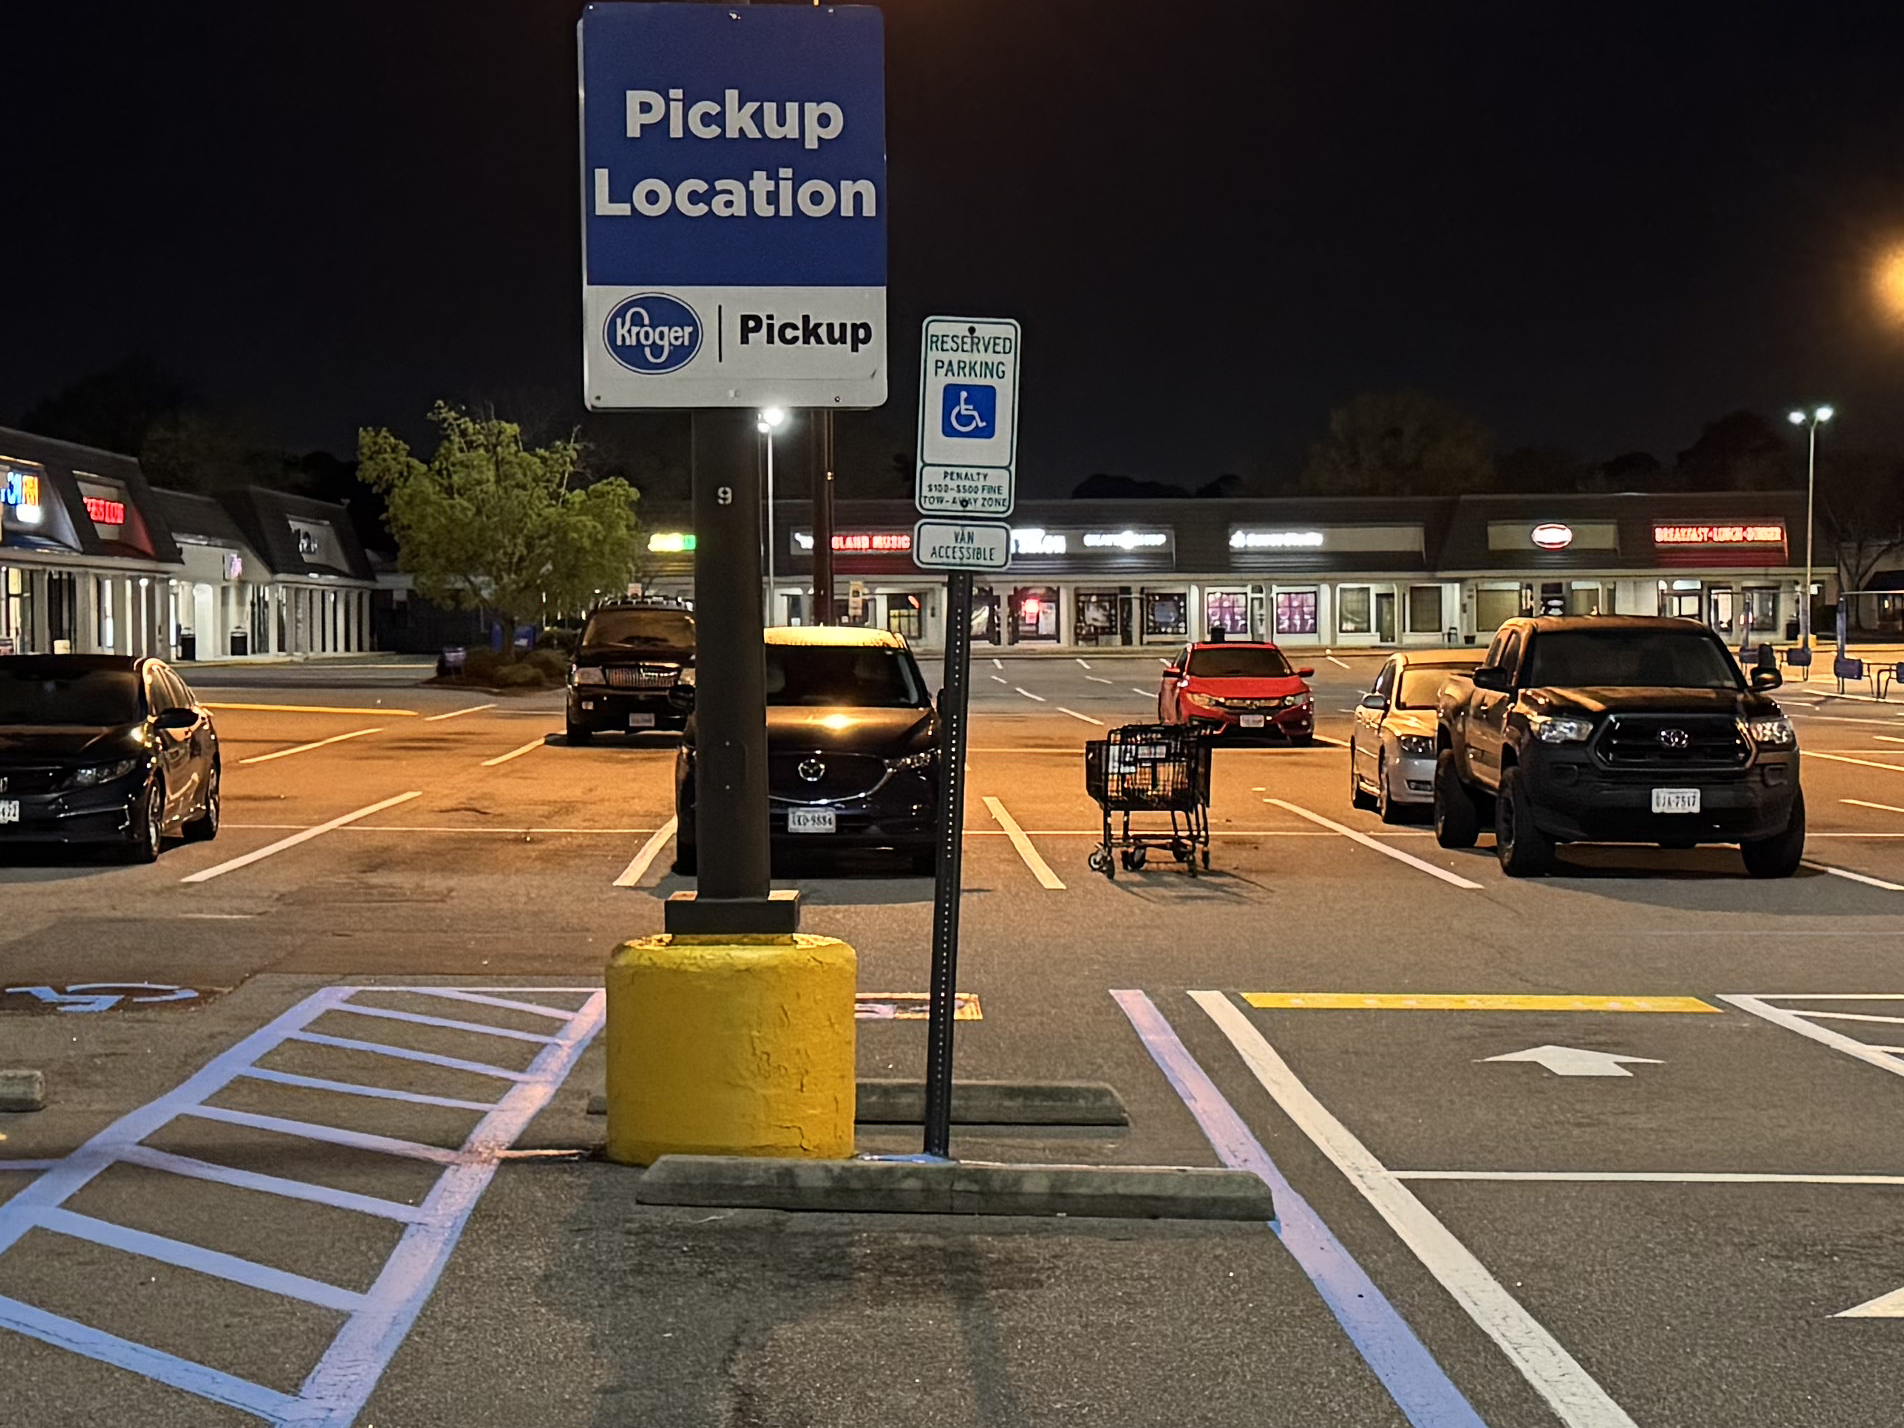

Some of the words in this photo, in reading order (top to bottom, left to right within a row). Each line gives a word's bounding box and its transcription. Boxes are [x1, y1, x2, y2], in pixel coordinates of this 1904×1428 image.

[625, 88, 844, 149] Pickup
[594, 167, 877, 218] Location
[616, 307, 694, 364] Kroger
[739, 313, 873, 353] Pickup
[929, 334, 1013, 355] RESERVED
[934, 359, 1006, 379] PARKING
[942, 471, 988, 482] PENALTY
[717, 486, 733, 505] 9
[981, 485, 1004, 495] FINE
[922, 495, 978, 507] TOW-AWAY
[980, 497, 1007, 508] ZONE
[953, 530, 975, 545] VAN
[930, 546, 995, 562] ACCESSIBLE
